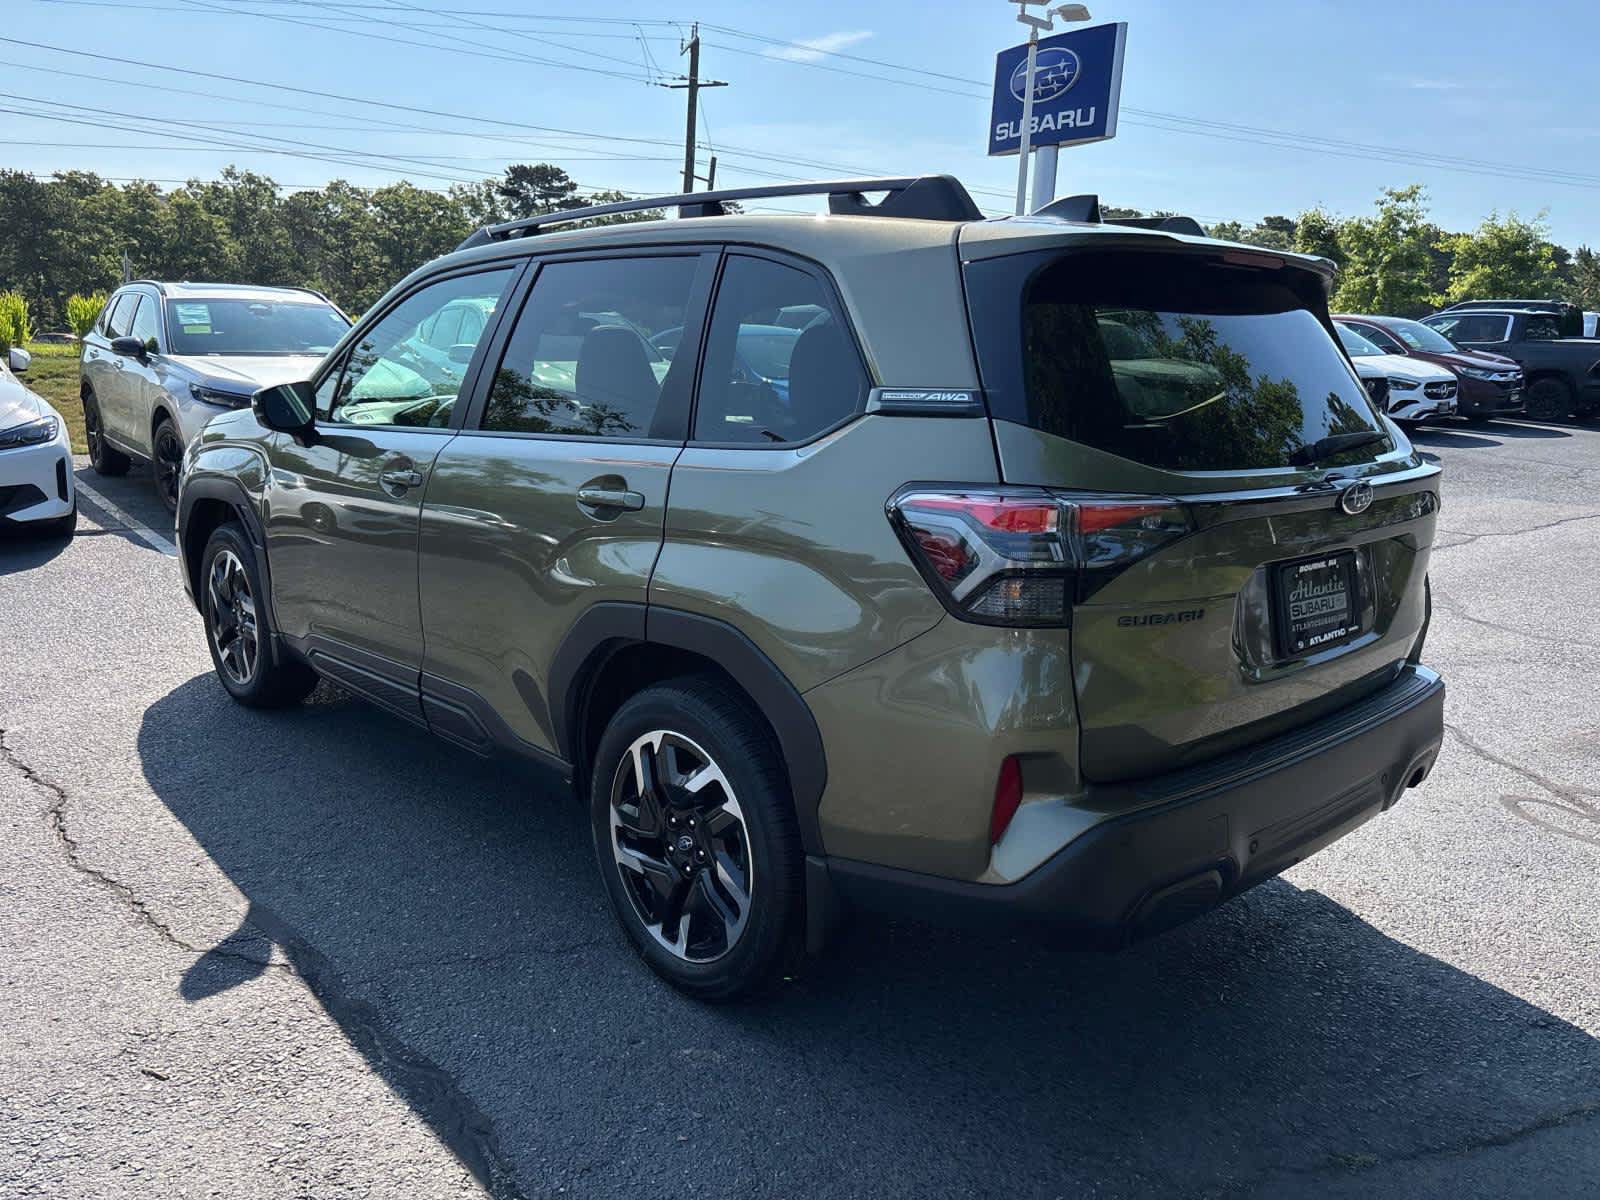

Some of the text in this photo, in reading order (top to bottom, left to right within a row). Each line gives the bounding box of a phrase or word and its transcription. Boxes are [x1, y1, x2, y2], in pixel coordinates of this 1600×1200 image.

[995, 107, 1096, 141] SUBARU
[926, 392, 969, 401] AWD
[1289, 575, 1345, 602] Atlantic
[1292, 597, 1335, 617] SUBARU
[1117, 609, 1205, 627] SUBARU
[1309, 628, 1346, 646] ATLANTIC
